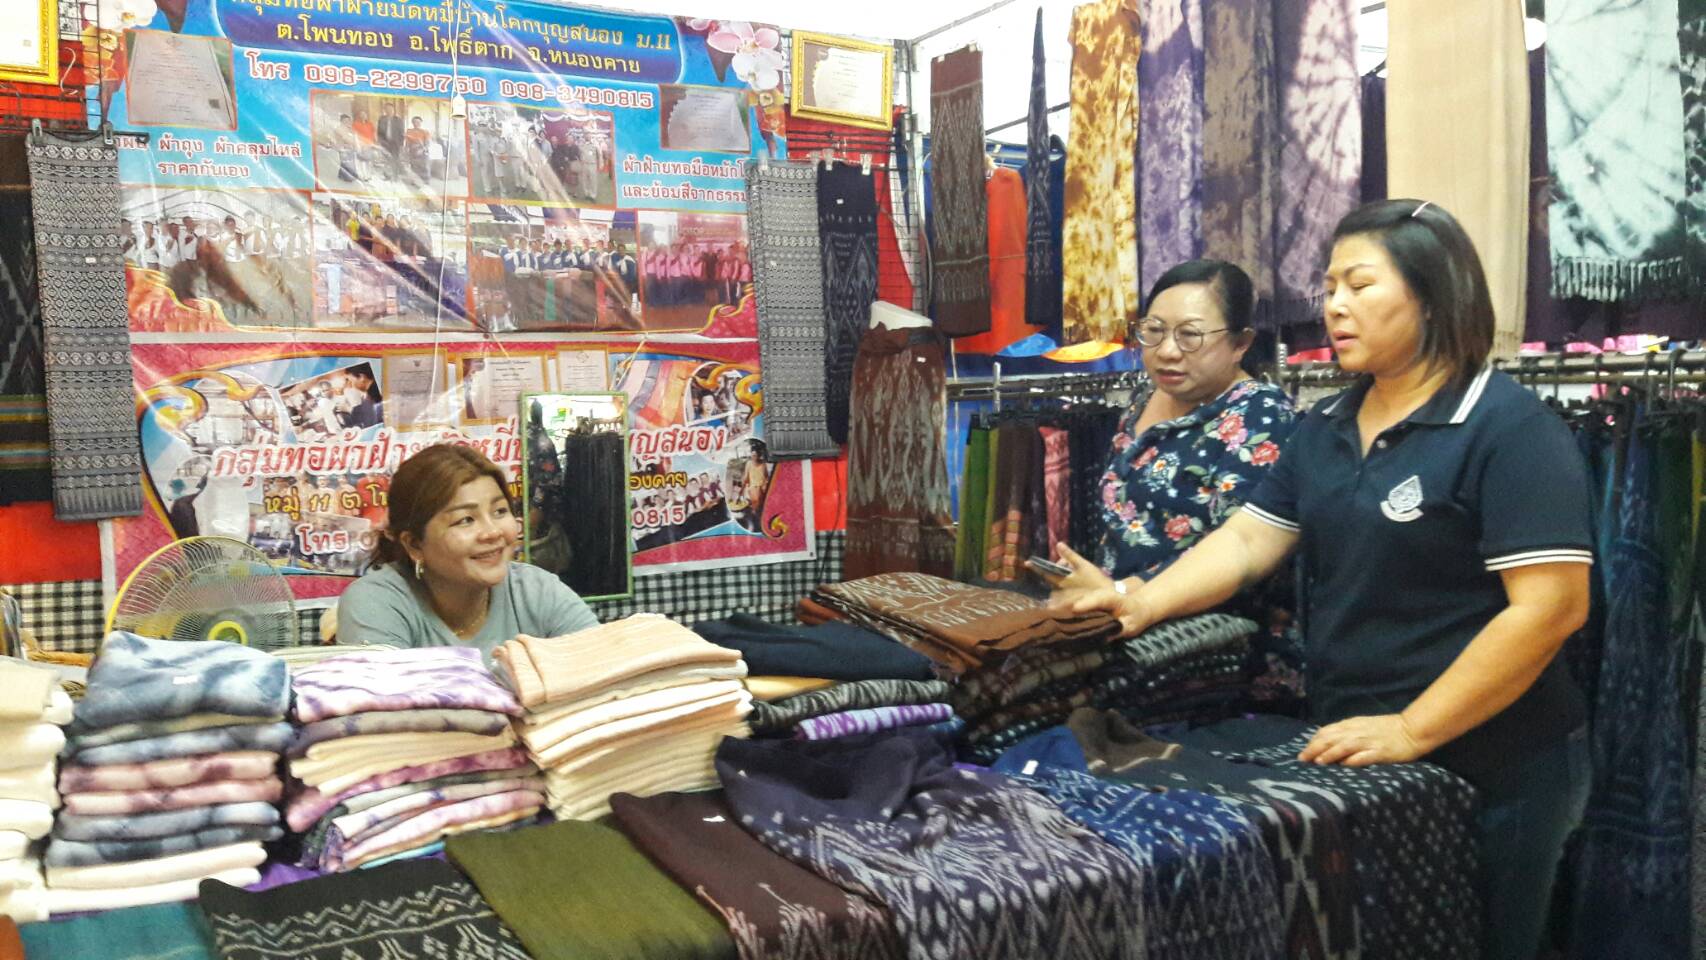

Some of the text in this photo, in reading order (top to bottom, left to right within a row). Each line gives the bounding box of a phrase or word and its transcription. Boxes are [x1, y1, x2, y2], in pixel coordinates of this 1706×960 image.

[277, 13, 641, 73] ต.โพนทอง อ.โพธิ์ตาก จ.หนองคาย
[247, 52, 289, 79] โทร
[306, 66, 485, 93] 098-2299750
[502, 81, 652, 107] 098-3490815
[160, 133, 203, 158] ผ้าถุง
[215, 137, 300, 160] ผ้าคลุมไหล่
[159, 160, 249, 177] ราคากันเอง
[264, 486, 299, 520] หมู่
[310, 494, 330, 511] 11
[300, 526, 347, 552] โทร
